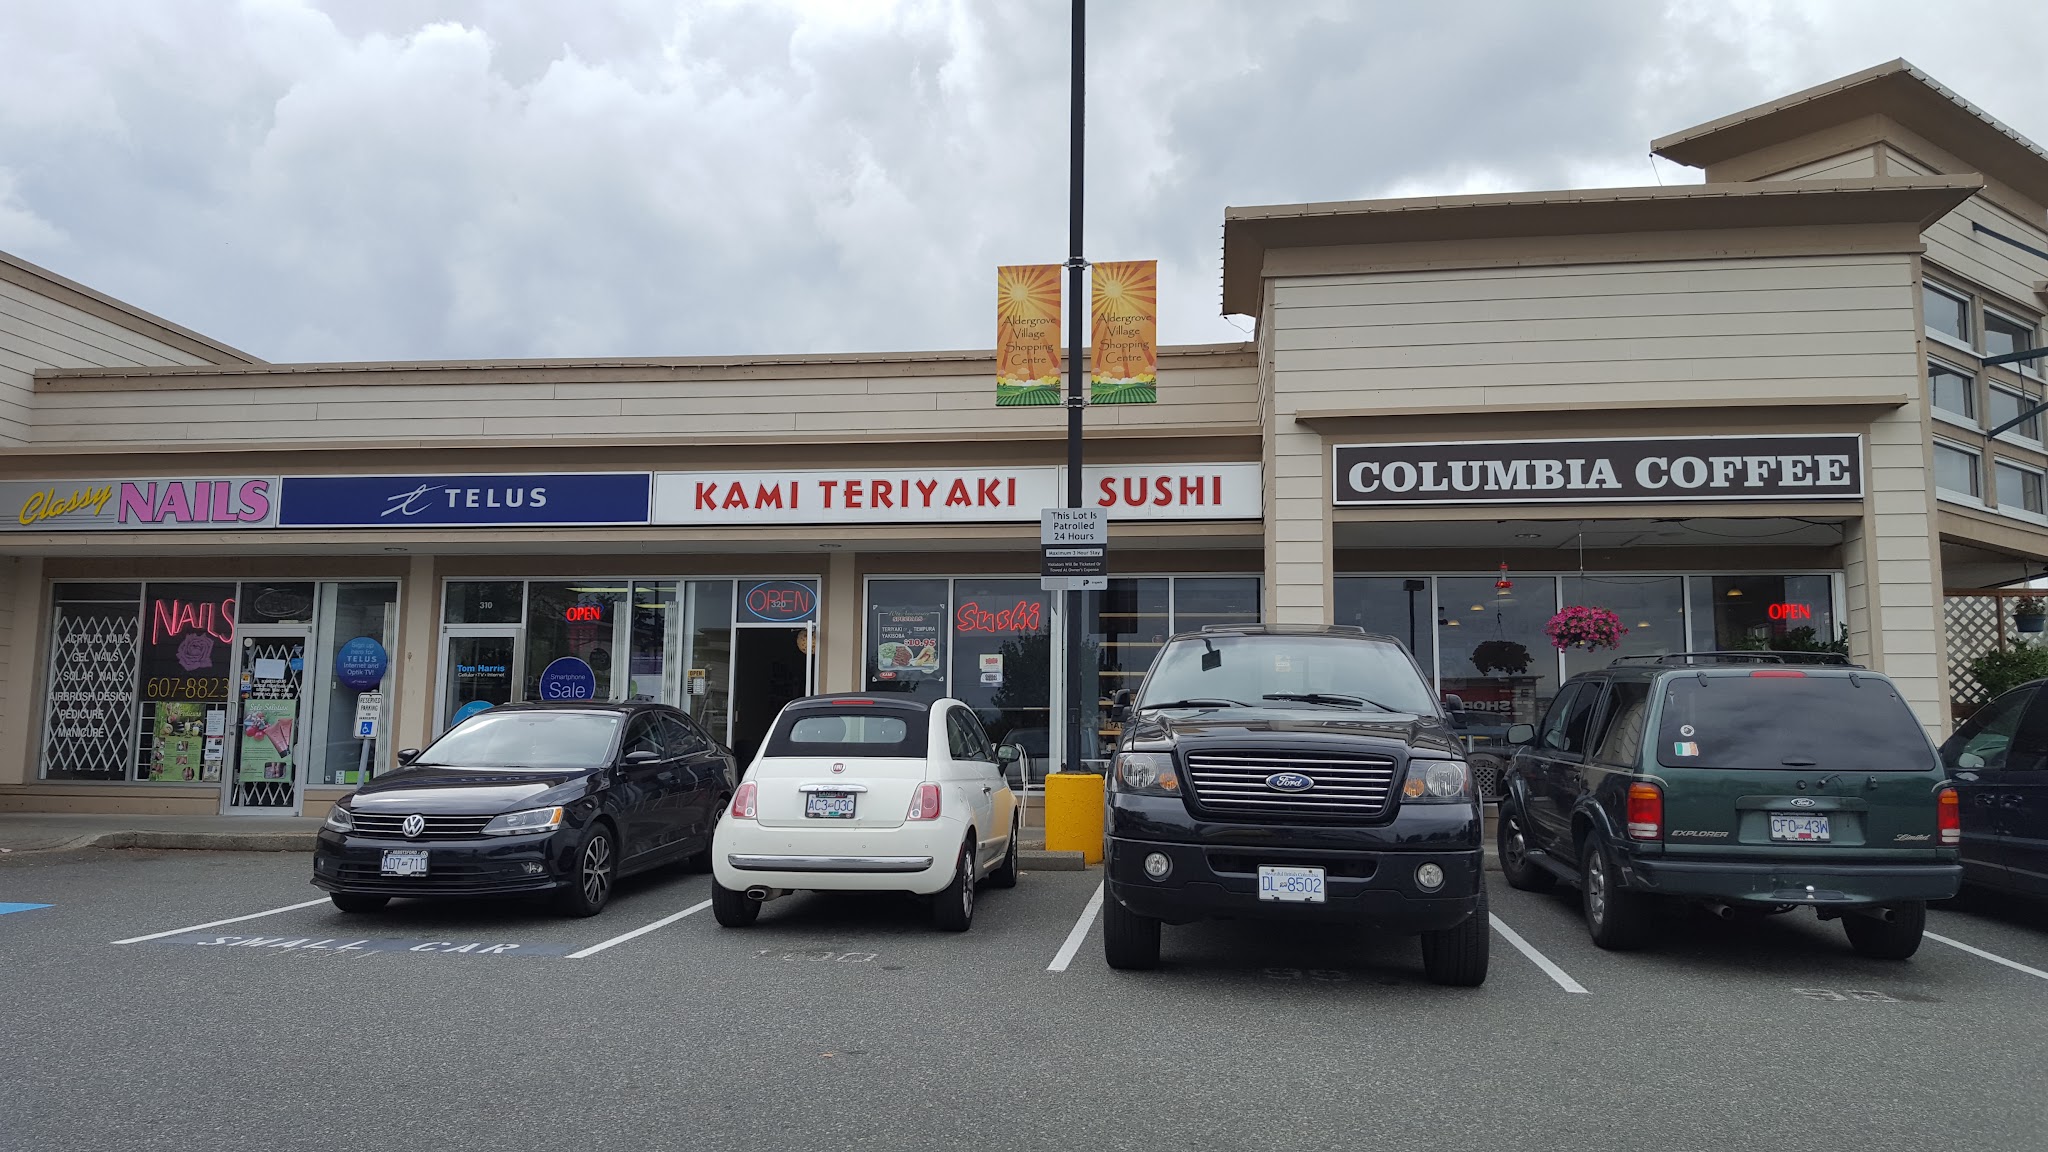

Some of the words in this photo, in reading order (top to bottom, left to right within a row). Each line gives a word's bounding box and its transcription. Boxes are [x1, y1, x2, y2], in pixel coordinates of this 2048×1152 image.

[1002, 315, 1056, 327] Aldergrove
[1098, 312, 1152, 326] Aldergrove
[1012, 328, 1045, 340] Village
[1106, 325, 1140, 338] Village
[1005, 341, 1054, 355] Shopping
[1099, 338, 1150, 352] Shopping
[1011, 354, 1047, 366] Centre
[1105, 351, 1142, 364] Centre
[1348, 458, 1622, 493] COLUMBIA
[1635, 454, 1851, 489] COFFEE
[444, 488, 547, 508] TELUS
[695, 480, 798, 510] KAMI
[818, 477, 1016, 509] TERIYAKI
[1098, 475, 1221, 507] SUSHI
[19, 484, 112, 526] Classy
[118, 480, 270, 523] NAILS
[1051, 512, 1070, 520] This
[1090, 511, 1097, 519] Is
[1053, 522, 1095, 530] Patrolled
[1054, 532, 1065, 540] 24
[1068, 532, 1094, 540] Hours
[479, 601, 493, 609] 310
[749, 589, 809, 612] OPEN
[566, 606, 601, 621] OPEN
[957, 600, 1040, 633] Sushi
[1768, 603, 1810, 620] OPEN
[152, 598, 236, 645] NAILS
[64, 633, 103, 643] ACRYLIC
[106, 633, 131, 643] NAILS
[903, 638, 936, 647] $10.95
[351, 642, 364, 650] Sign
[72, 652, 89, 662] GEL
[94, 652, 119, 661] NAILS
[457, 664, 475, 672] Tom
[477, 664, 505, 672] Harris
[63, 671, 93, 681] SOLAR
[100, 671, 124, 681] NAILS
[550, 673, 586, 681] Smartphone
[147, 677, 229, 698] 607-8823
[548, 681, 586, 699] Sale
[49, 691, 95, 701] AIRBRUSH
[97, 691, 132, 701] DESIGN
[60, 709, 104, 719] PEDICURE
[58, 727, 104, 738] MANICURE
[1276, 775, 1303, 787] Ford
[1671, 829, 1729, 838] EXPLORER
[1893, 833, 1931, 842] Limited
[197, 936, 369, 950] SMALL
[409, 941, 520, 954] CAR
